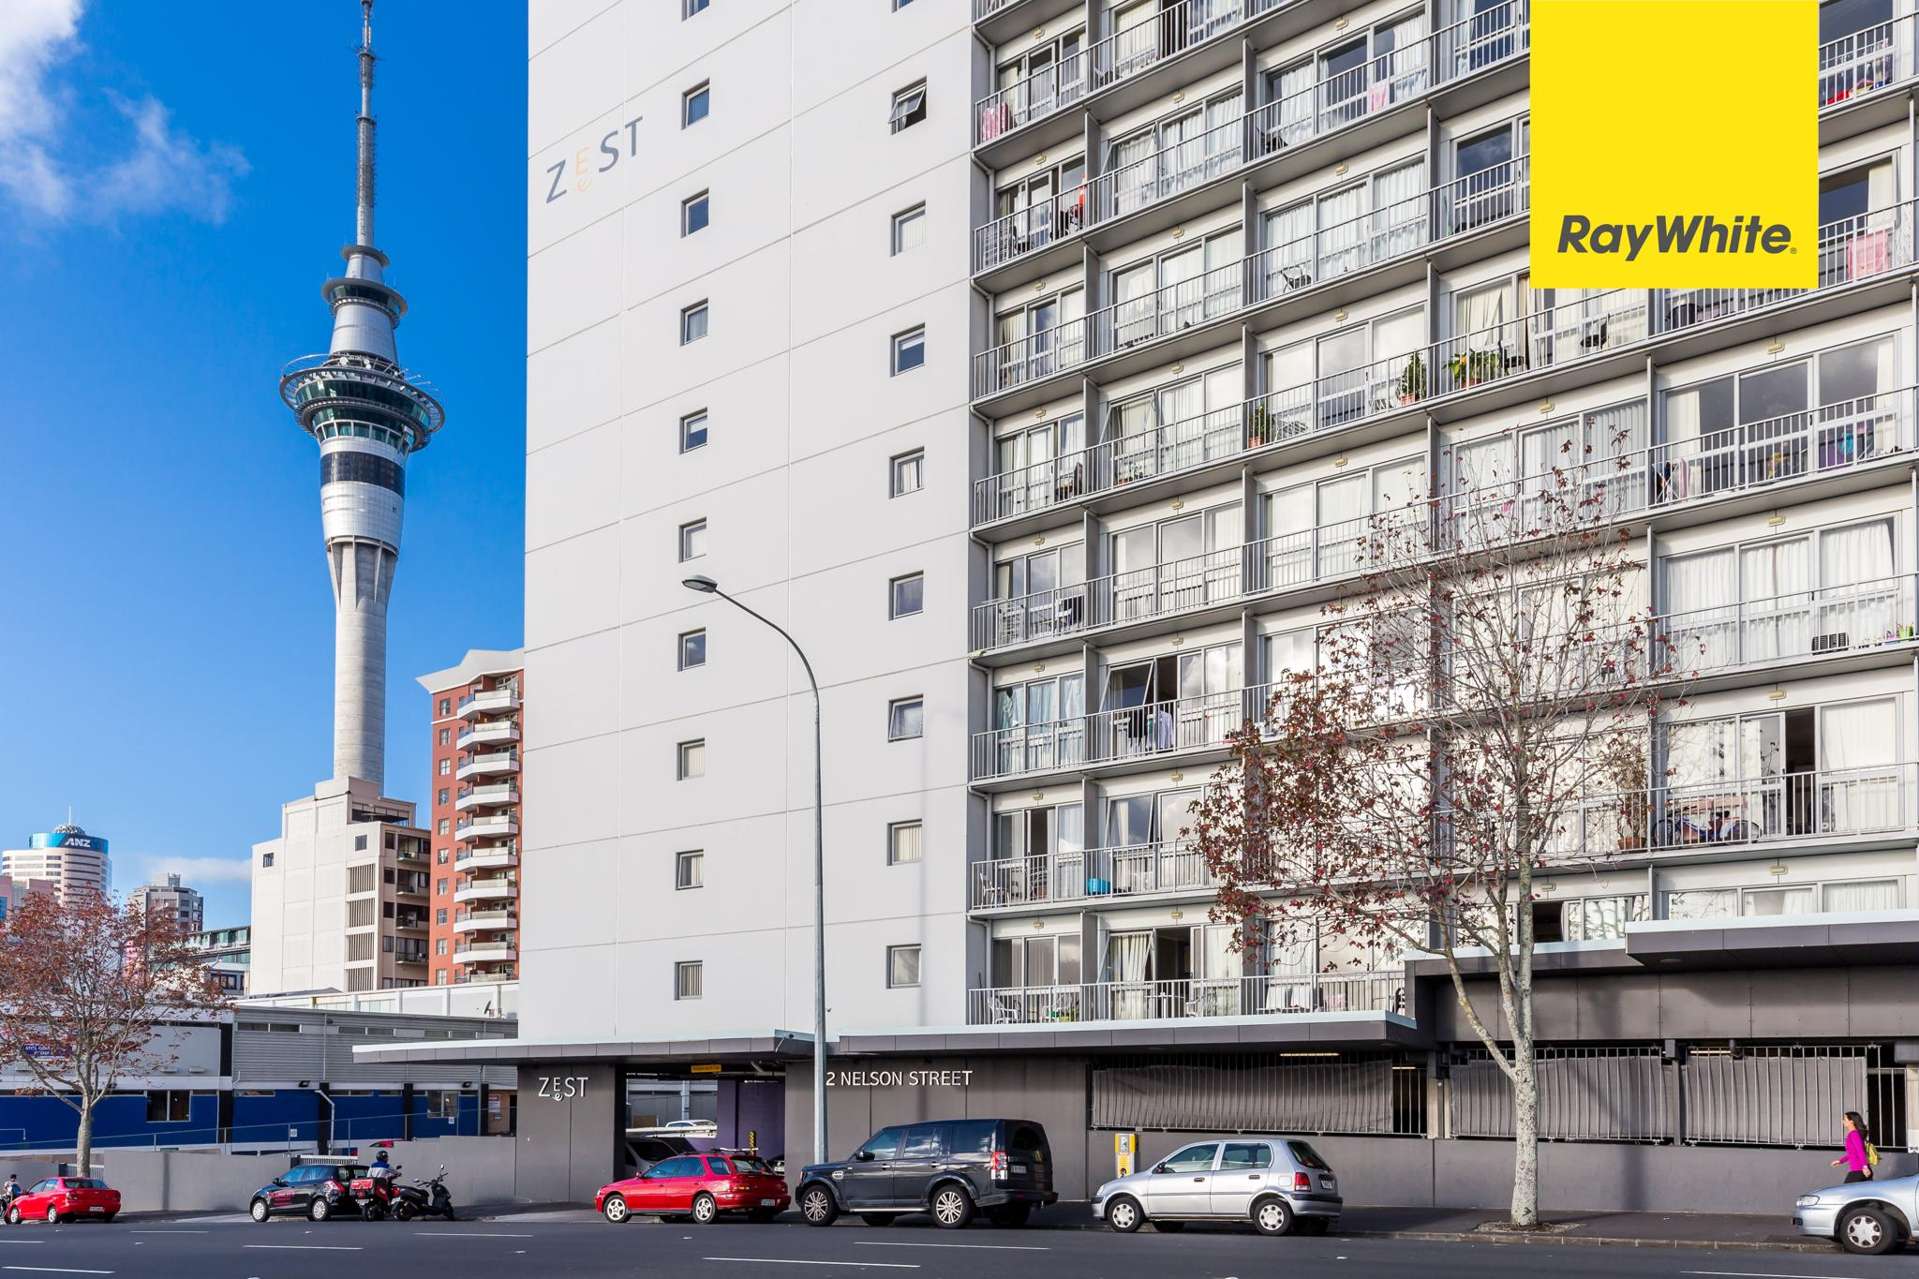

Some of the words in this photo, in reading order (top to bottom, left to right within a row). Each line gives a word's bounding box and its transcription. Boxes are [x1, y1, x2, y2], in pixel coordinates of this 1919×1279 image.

[546, 115, 643, 204] ZEST
[64, 838, 91, 848] ANZ
[825, 1071, 836, 1086] 2
[840, 1071, 903, 1086] NELSON
[908, 1070, 973, 1086] STREET
[539, 1077, 589, 1099] ZEST
